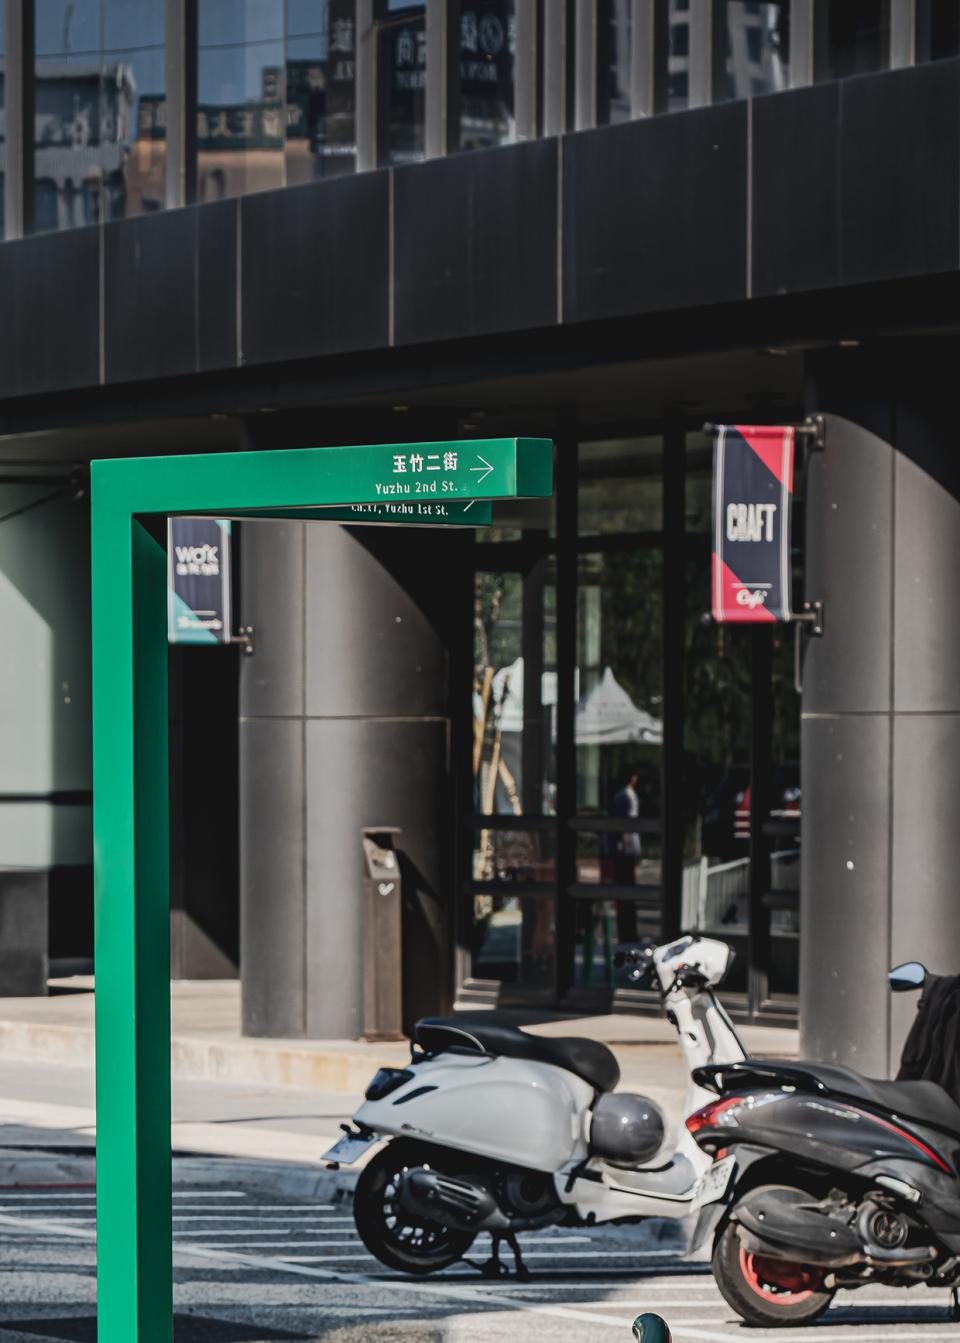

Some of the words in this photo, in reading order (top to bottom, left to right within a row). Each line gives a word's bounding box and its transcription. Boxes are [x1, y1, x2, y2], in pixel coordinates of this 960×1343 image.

[392, 451, 458, 473] 玉竹二街
[375, 482, 411, 495] Yuzhu
[415, 480, 437, 493] 2nd
[442, 480, 459, 492] St.
[385, 503, 414, 514] Yuzhu
[435, 504, 449, 516] St.
[726, 503, 777, 542] CRAFT
[175, 544, 219, 563] WOK
